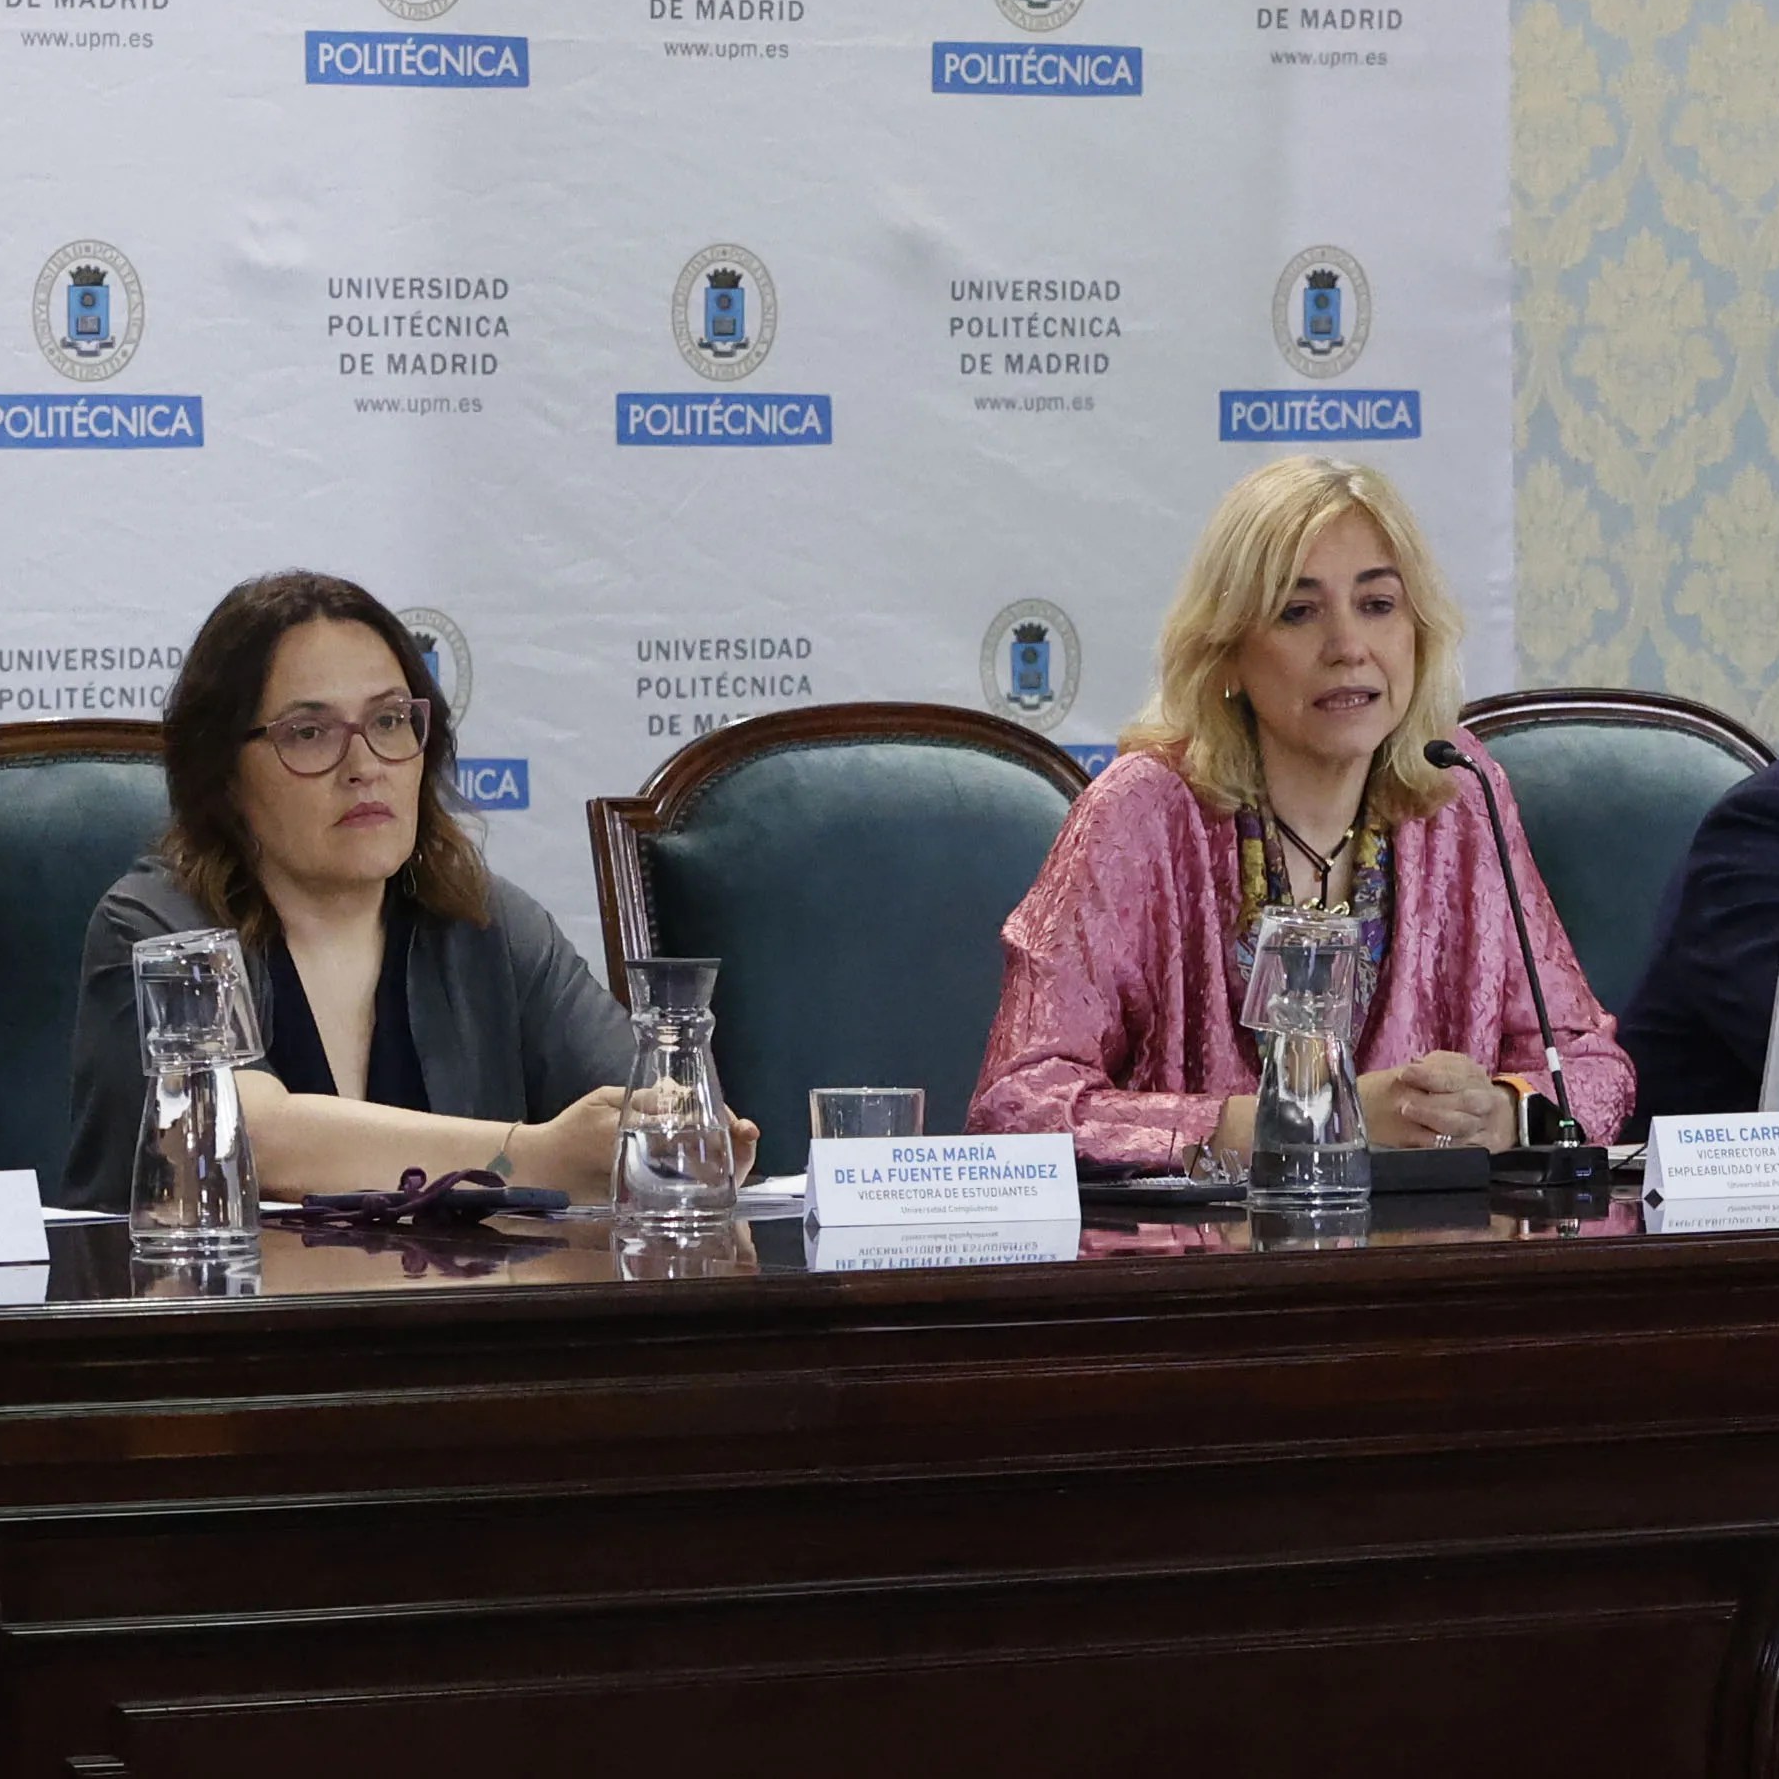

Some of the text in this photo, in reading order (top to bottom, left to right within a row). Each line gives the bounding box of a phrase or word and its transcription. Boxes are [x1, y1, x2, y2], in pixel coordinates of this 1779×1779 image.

[697, 0, 804, 21] MADRID
[1258, 9, 1402, 29] DE MADRID
[21, 32, 153, 51] www.upm.es
[664, 43, 788, 60] www.upm.es
[319, 37, 518, 77] POLITÉCNICA
[945, 48, 1133, 86] POLITÉCNICA
[1271, 52, 1387, 68] www.upm.es
[329, 278, 508, 299] UNIVERSIDAD
[951, 280, 1120, 301] UNIVERSIDAD
[329, 311, 508, 337] POLITÉCNICA
[950, 312, 1120, 338] POLITÉCNICA
[340, 353, 497, 375] DE MADRID
[961, 353, 1109, 374] DE MADRID
[355, 397, 483, 416] www.upm.es
[975, 396, 1094, 412] www.upm.es
[1232, 395, 1412, 431] POLITÉCNICA
[630, 399, 821, 435] POLITÉCNICA
[637, 637, 812, 662] UNIVERSIDAD
[637, 672, 812, 699] POLITÉCNICA
[648, 715, 681, 736] DE
[1677, 1127, 1735, 1144] ISABEL
[893, 1141, 997, 1163] ROSA MARÍA
[1696, 1146, 1776, 1159] VICERRECTORA
[835, 1161, 1058, 1184] DE LA FUENTE FERNÁNDEZ
[1667, 1163, 1753, 1177] EMPLEABILIDAD
[1756, 1163, 1763, 1174] Y
[858, 1185, 1038, 1201] VICERRECTORA DE ESTUDIANTES
